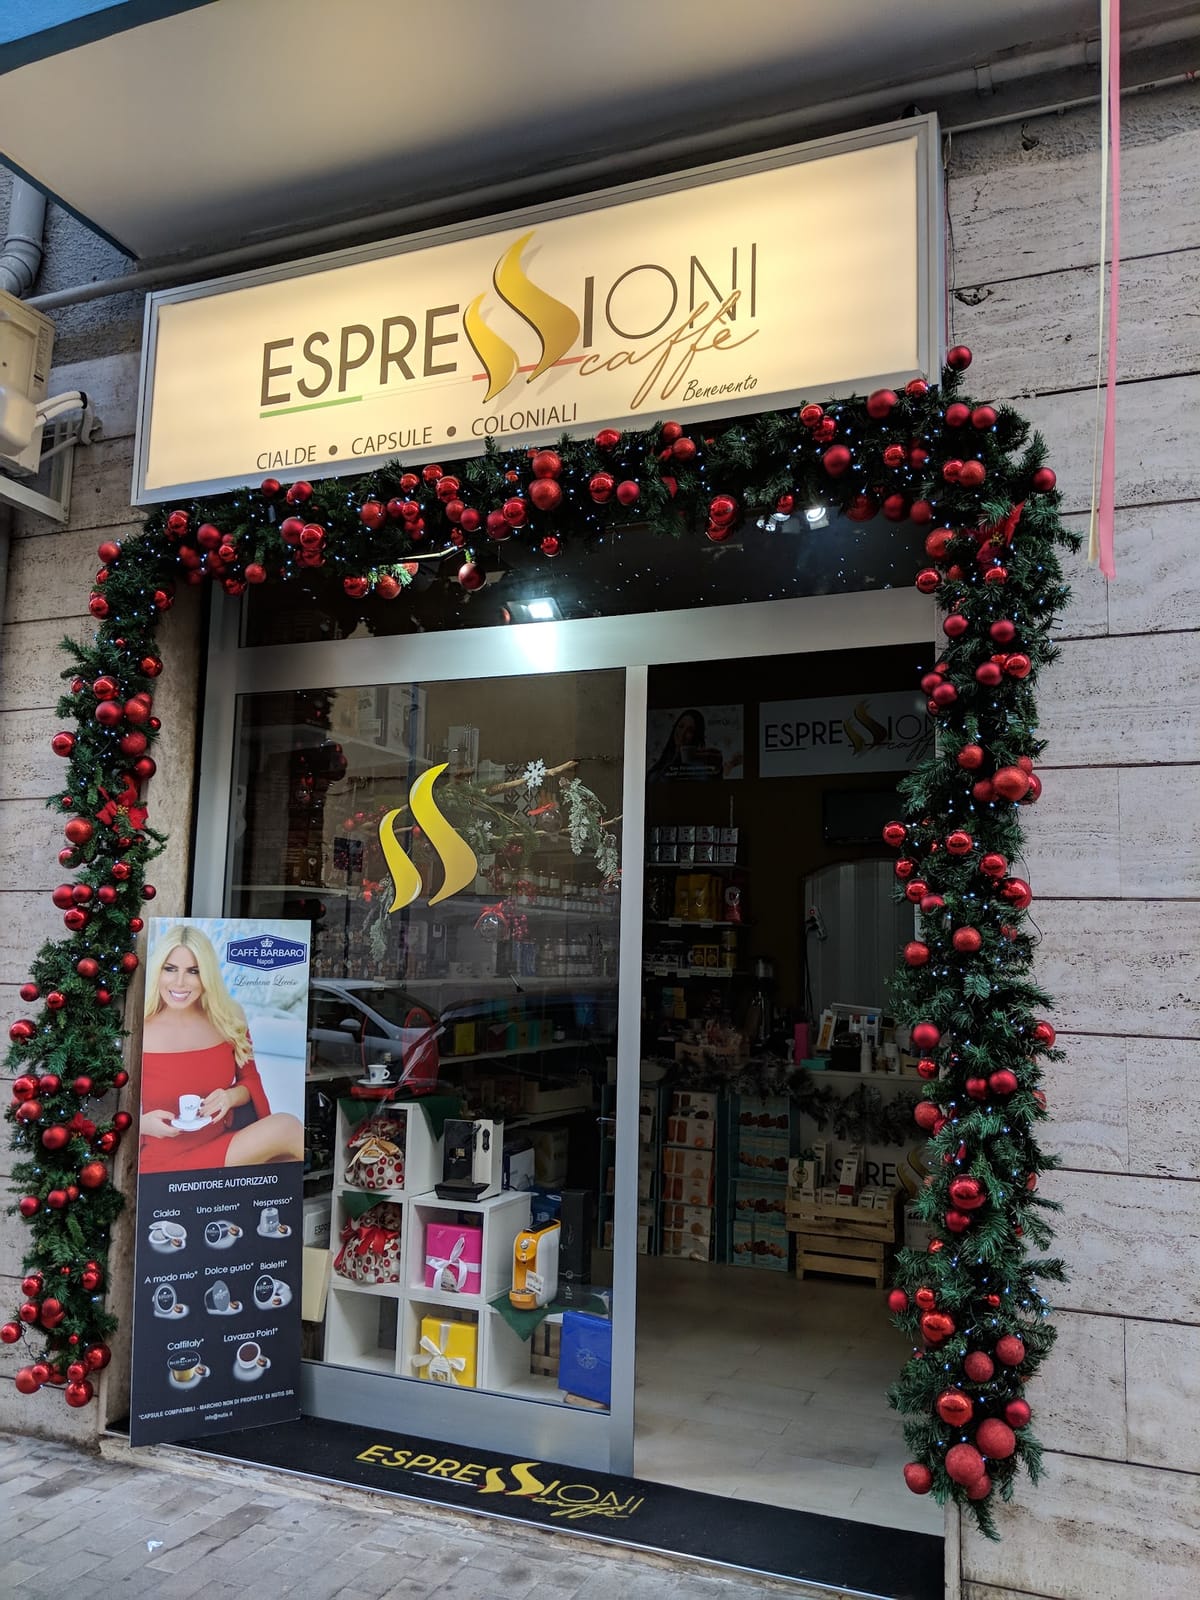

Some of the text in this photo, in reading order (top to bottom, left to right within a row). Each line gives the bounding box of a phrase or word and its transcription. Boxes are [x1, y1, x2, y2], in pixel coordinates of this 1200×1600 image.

[260, 230, 757, 407] ESPRESSIONI
[683, 376, 758, 402] Benevento
[256, 403, 577, 470] CIALDE CAPSULE COLONIALI
[230, 947, 304, 957] CAFFÈ BARBARO
[168, 1175, 278, 1193] RIVENDITORE AUTORIZZATO
[153, 1209, 181, 1218] Cialda
[196, 1206, 213, 1214] Uno
[204, 1267, 229, 1276] Dolce
[144, 1276, 151, 1284] A
[153, 1274, 178, 1283] modo
[223, 1331, 255, 1343] Lavazza
[164, 1406, 196, 1416] COMPATIBILI
